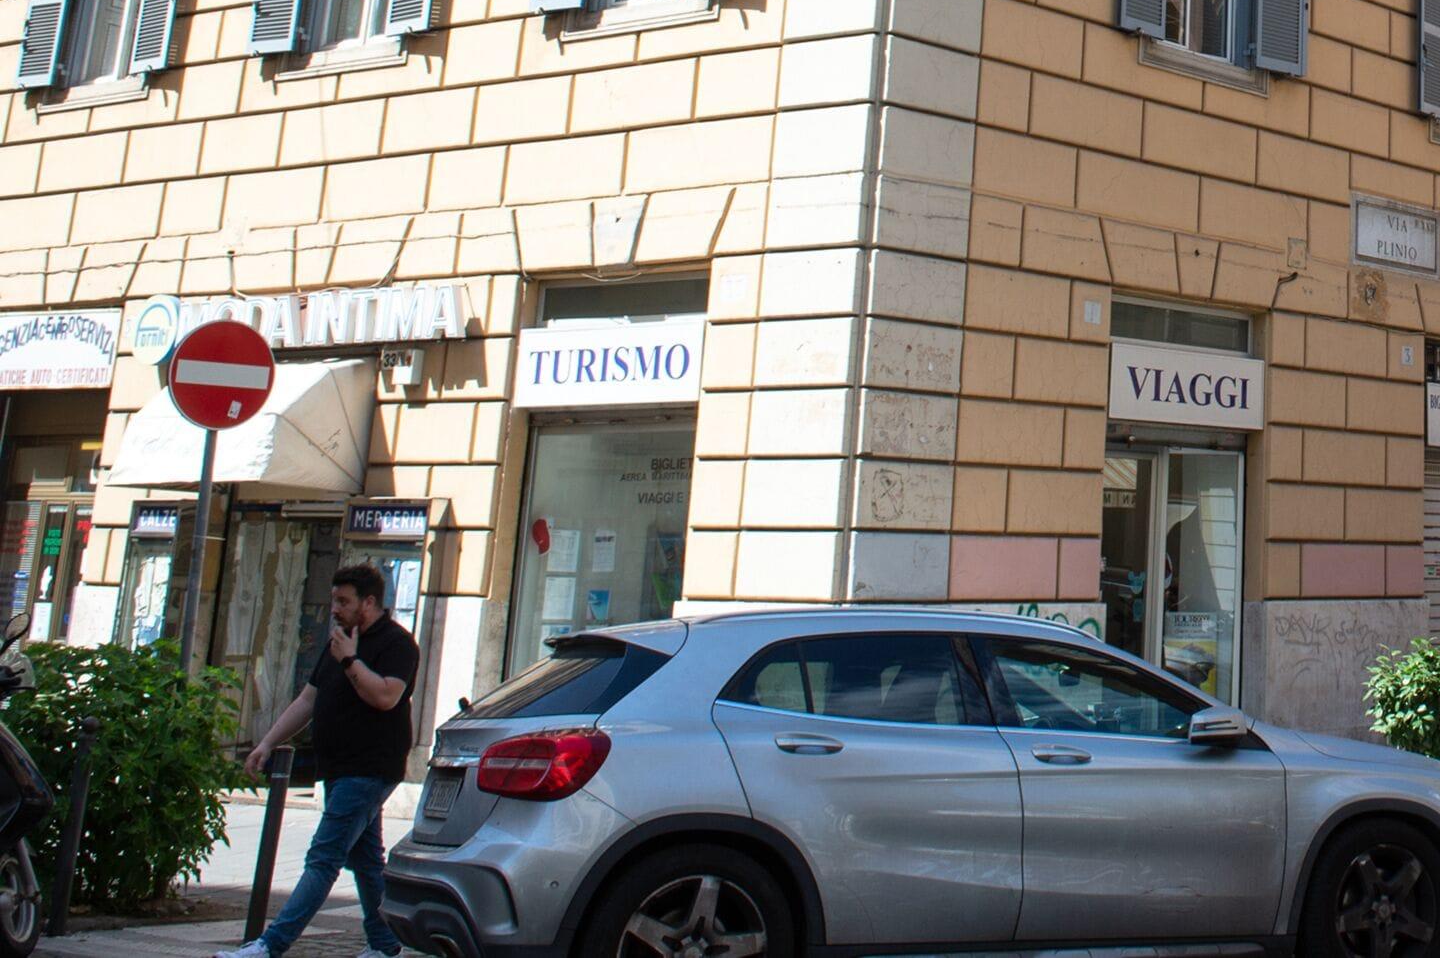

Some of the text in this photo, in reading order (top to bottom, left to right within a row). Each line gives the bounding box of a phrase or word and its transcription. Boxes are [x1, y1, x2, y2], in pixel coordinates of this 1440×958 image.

[1387, 214, 1408, 234] VIA
[1377, 240, 1418, 261] PLINIO
[302, 285, 466, 344] INTIMA
[75, 315, 116, 366] SERVIZI
[529, 343, 690, 385] TURISMO
[1404, 348, 1411, 363] 3
[31, 368, 53, 385] AUTO
[56, 367, 109, 385] CERTIFICATI
[1126, 365, 1250, 410] VIAGGI
[620, 472, 648, 482] AEREA
[638, 492, 684, 504] VIAGGI E
[140, 509, 177, 528] CALZE
[354, 509, 424, 529] MERCERIA
